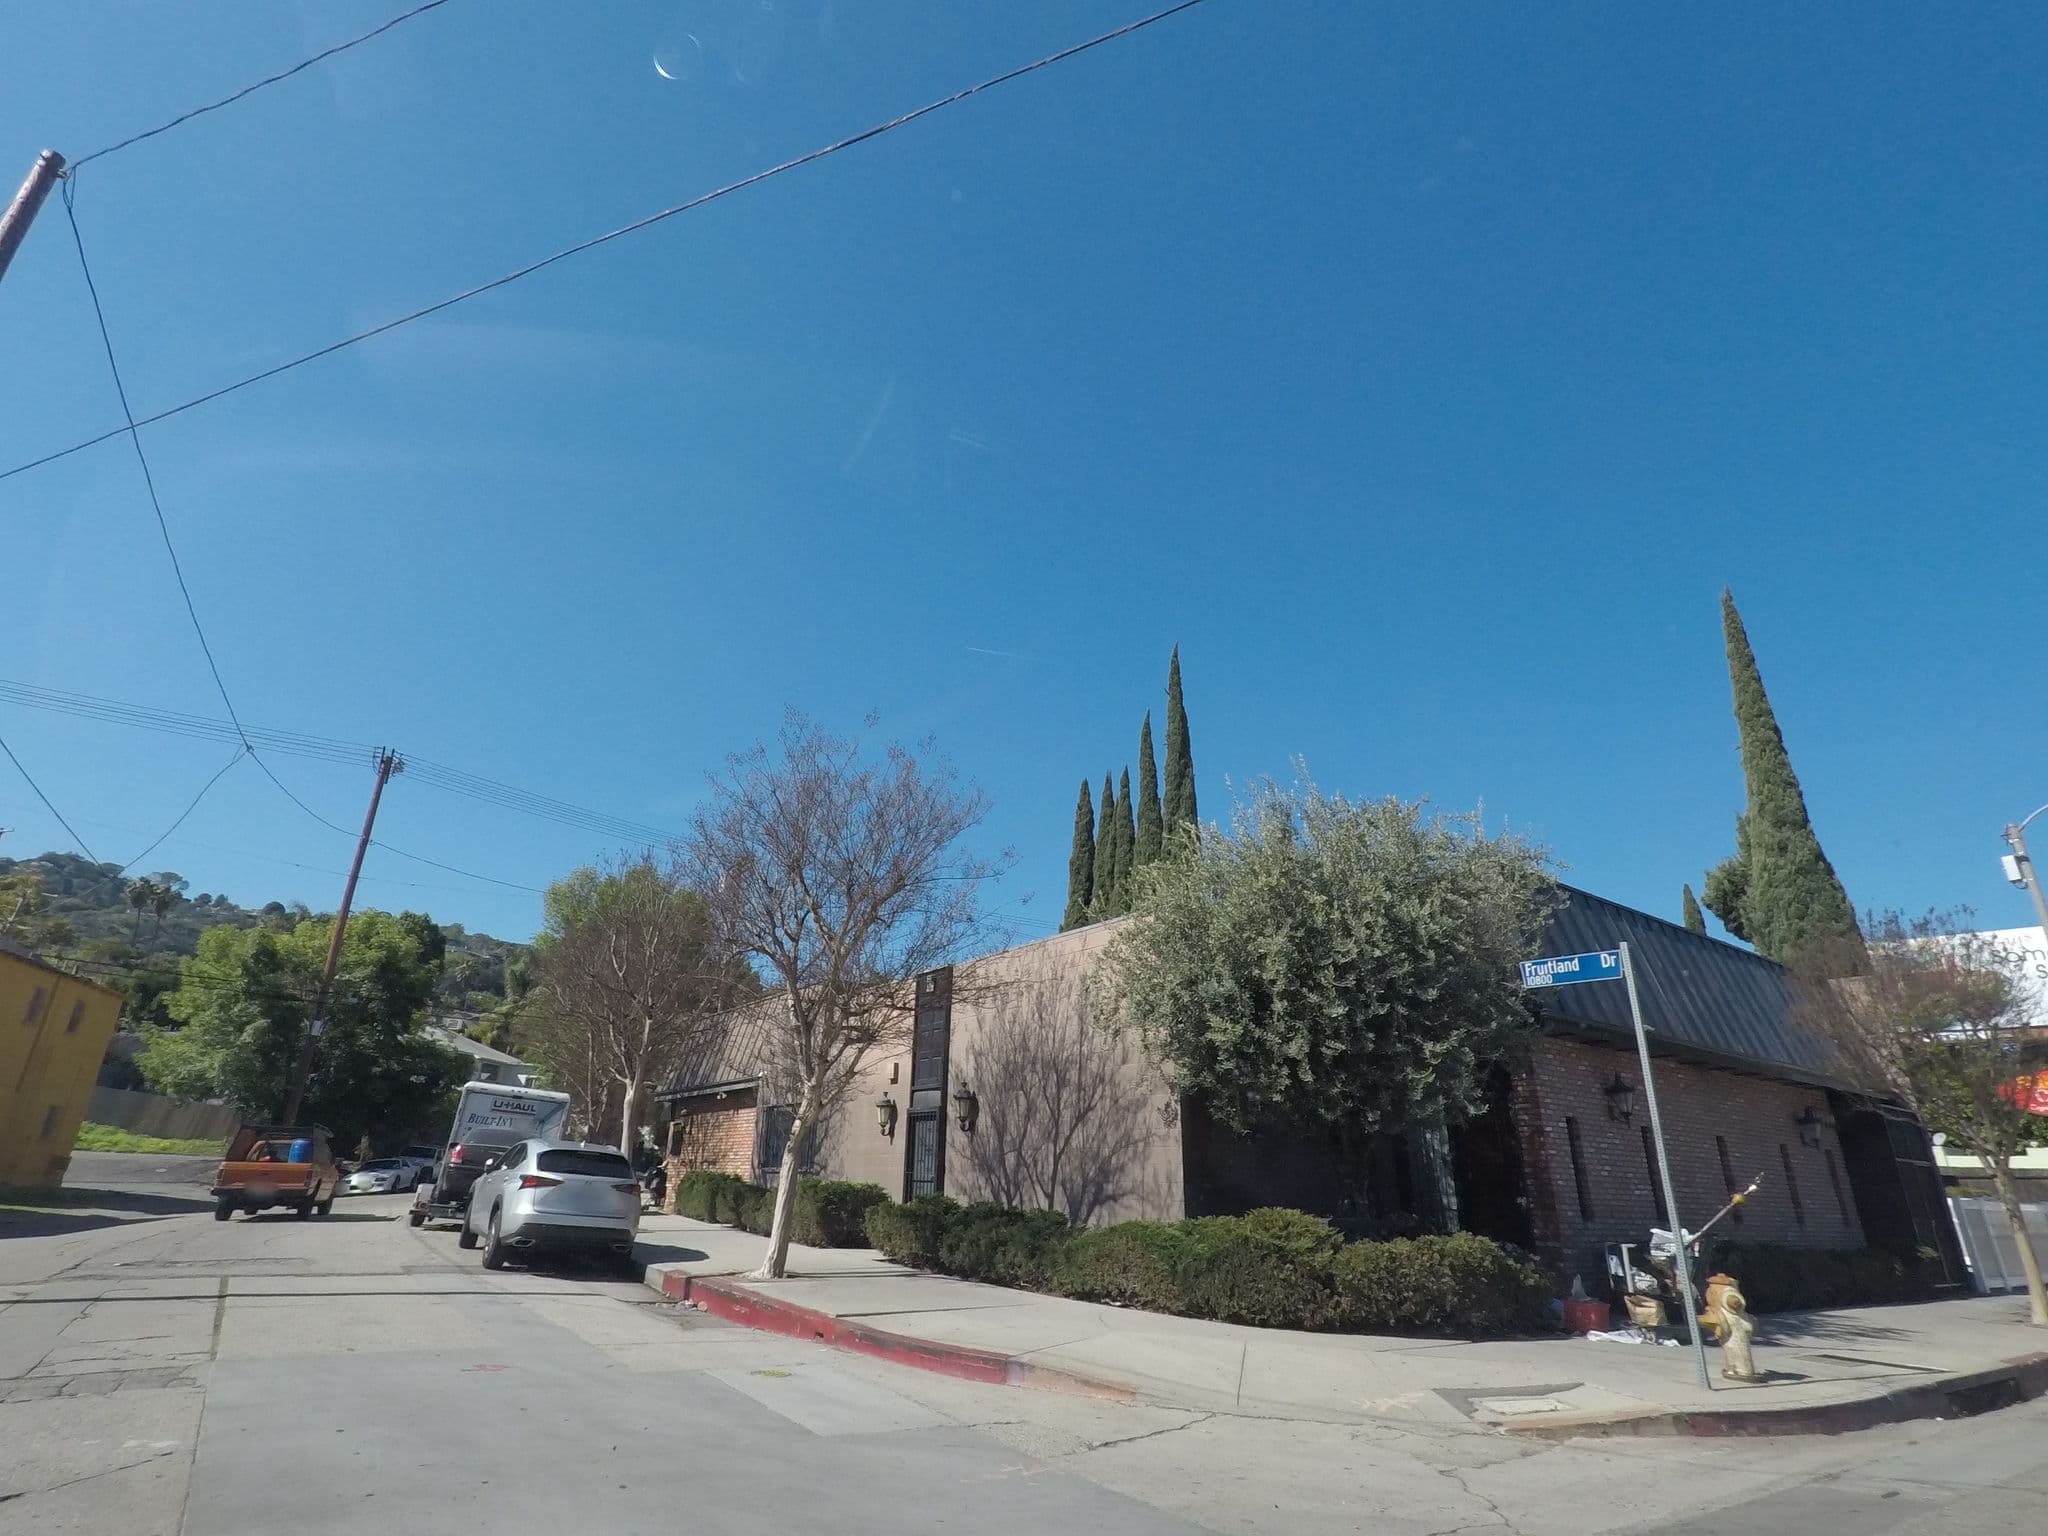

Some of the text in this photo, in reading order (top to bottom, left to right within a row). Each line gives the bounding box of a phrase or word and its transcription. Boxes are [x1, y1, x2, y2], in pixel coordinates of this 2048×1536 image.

[1992, 946, 2048, 964] som
[1524, 953, 1617, 977] Fruitland Dr
[1526, 974, 1553, 986] 10800
[493, 1100, 536, 1112] U-HAUL
